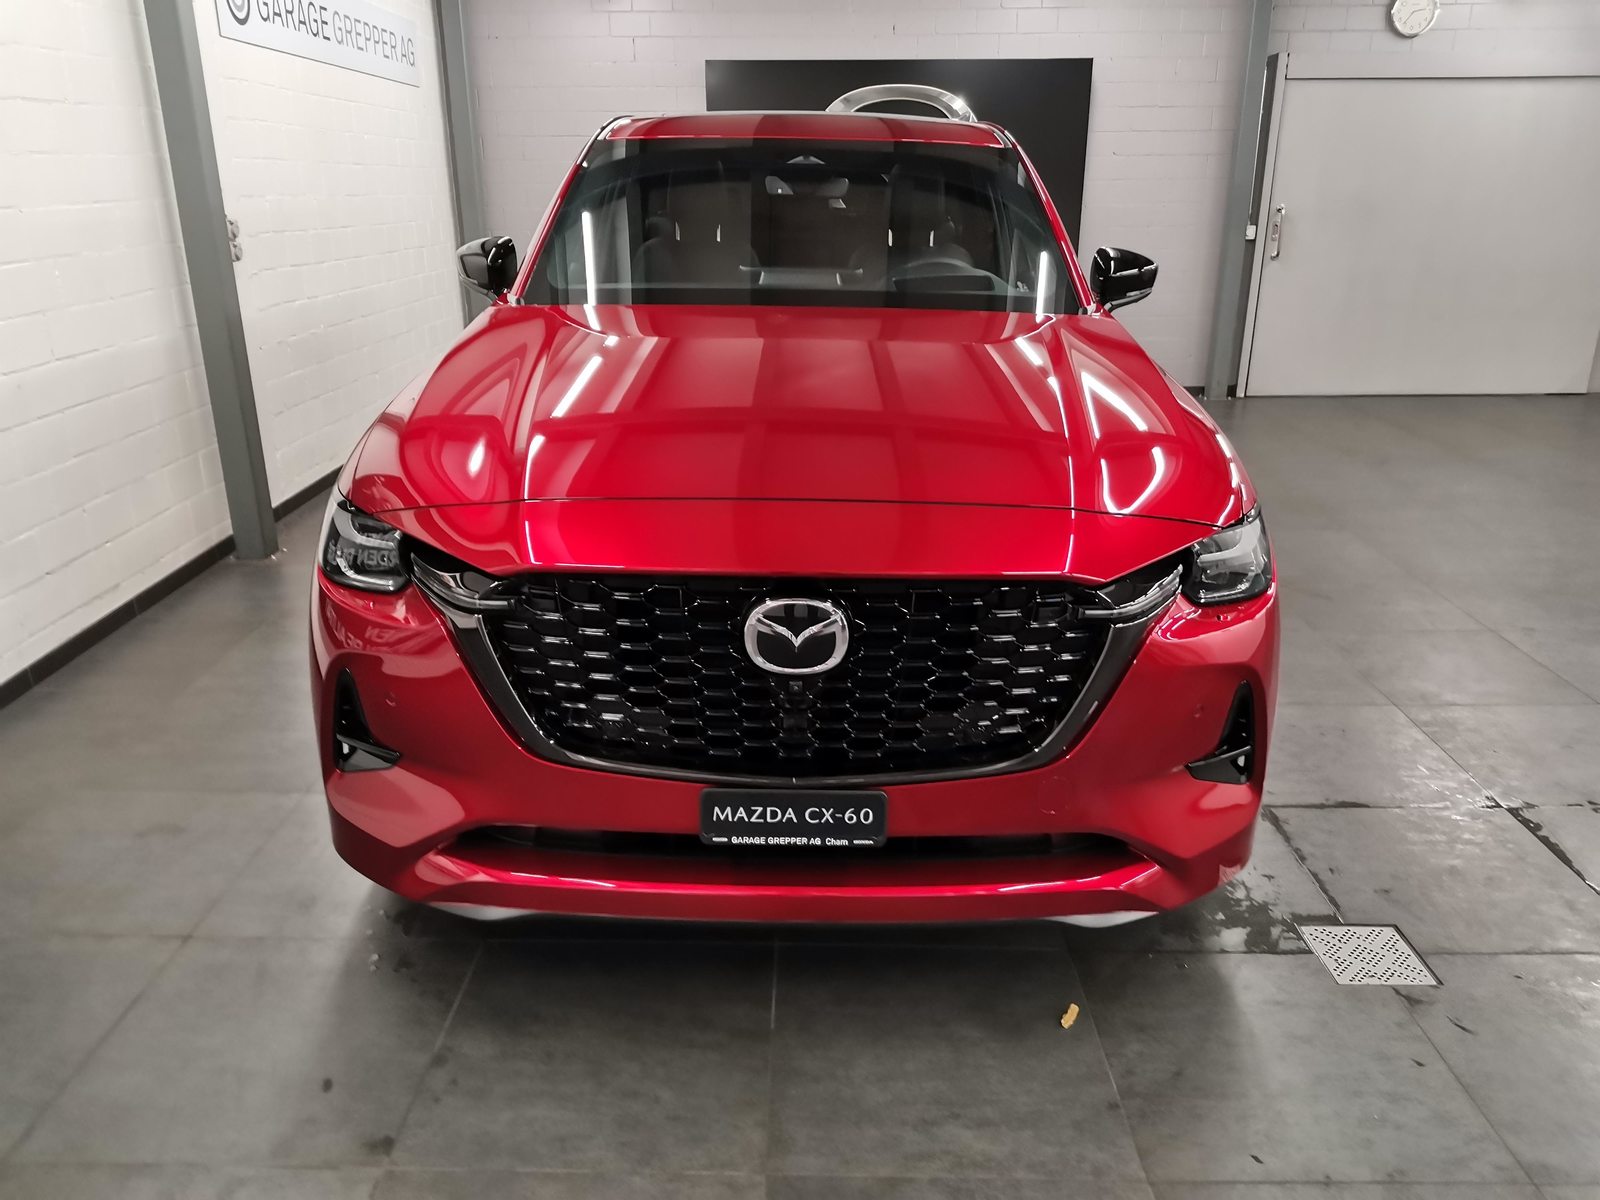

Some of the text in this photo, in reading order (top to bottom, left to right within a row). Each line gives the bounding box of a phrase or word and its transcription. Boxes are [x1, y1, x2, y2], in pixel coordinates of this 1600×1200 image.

[256, 0, 416, 67] GARAGE GREPPER AG
[712, 806, 874, 825] MAZDA CX-60
[731, 836, 766, 844] GARAGE
[767, 837, 807, 845] GREPPER
[825, 838, 849, 846] Cham
